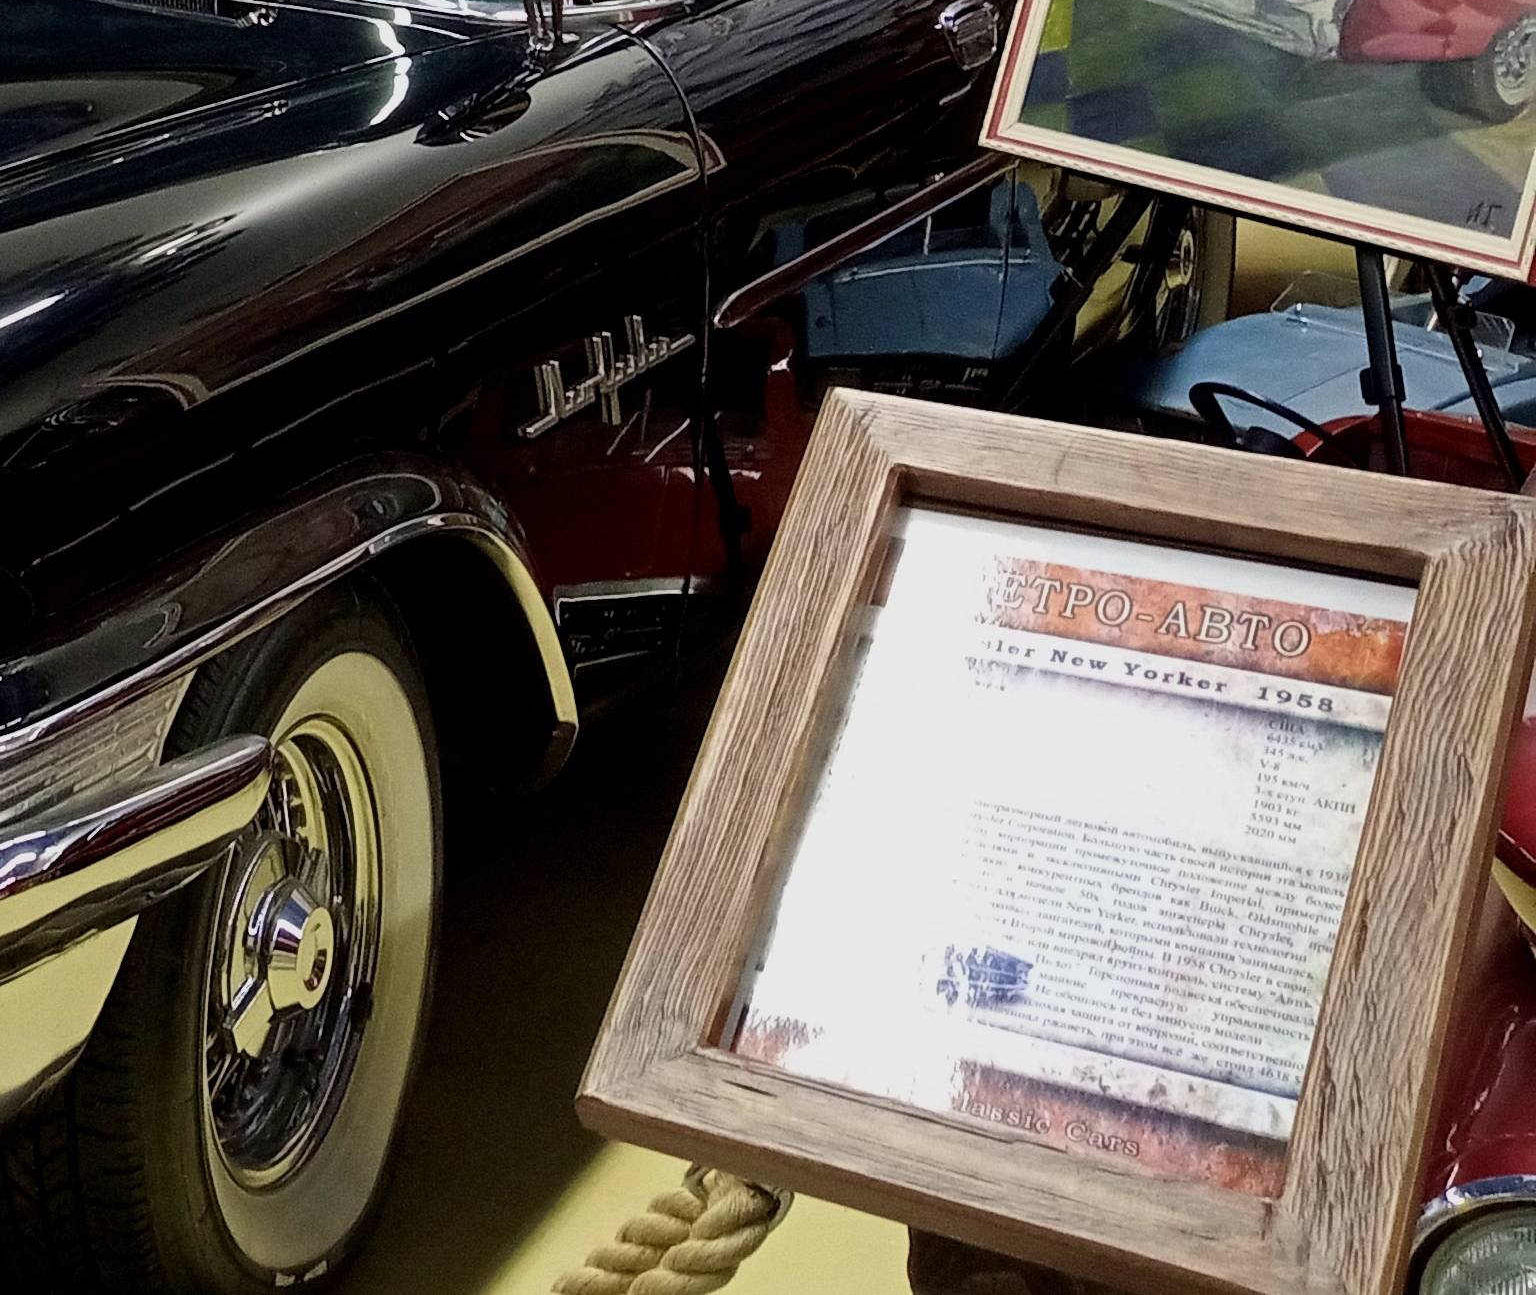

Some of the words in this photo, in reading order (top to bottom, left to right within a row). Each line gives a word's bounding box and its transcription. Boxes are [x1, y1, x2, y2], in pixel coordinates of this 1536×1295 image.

[997, 572, 1313, 659] ЕТРО-АВТО
[1050, 648, 1109, 672] New
[1123, 661, 1228, 694] Yorker
[1256, 686, 1335, 714] 1958
[1312, 796, 1357, 815] АКПП
[1243, 824, 1276, 841] 2020
[1179, 854, 1216, 870] своей
[1148, 874, 1202, 897] Chrysler
[1253, 885, 1296, 903] между
[1169, 896, 1192, 908] как
[1198, 899, 1241, 919] Buick,
[1246, 910, 1320, 936] Oldsmobile
[1064, 900, 1093, 915] New
[1094, 905, 1141, 926] Yorker,
[1232, 938, 1308, 964] технологии
[1236, 922, 1296, 948] Chrysler,
[1173, 940, 1236, 963] компания
[1176, 953, 1207, 970] 1958
[1207, 960, 1263, 985] Chrysler
[1209, 978, 1265, 1002] систему
[1116, 1019, 1132, 1030] от
[1127, 1035, 1159, 1051] этом
[1213, 1026, 1263, 1047] модели
[959, 1089, 1052, 1135] lassic
[1064, 1120, 1141, 1157] Cars
